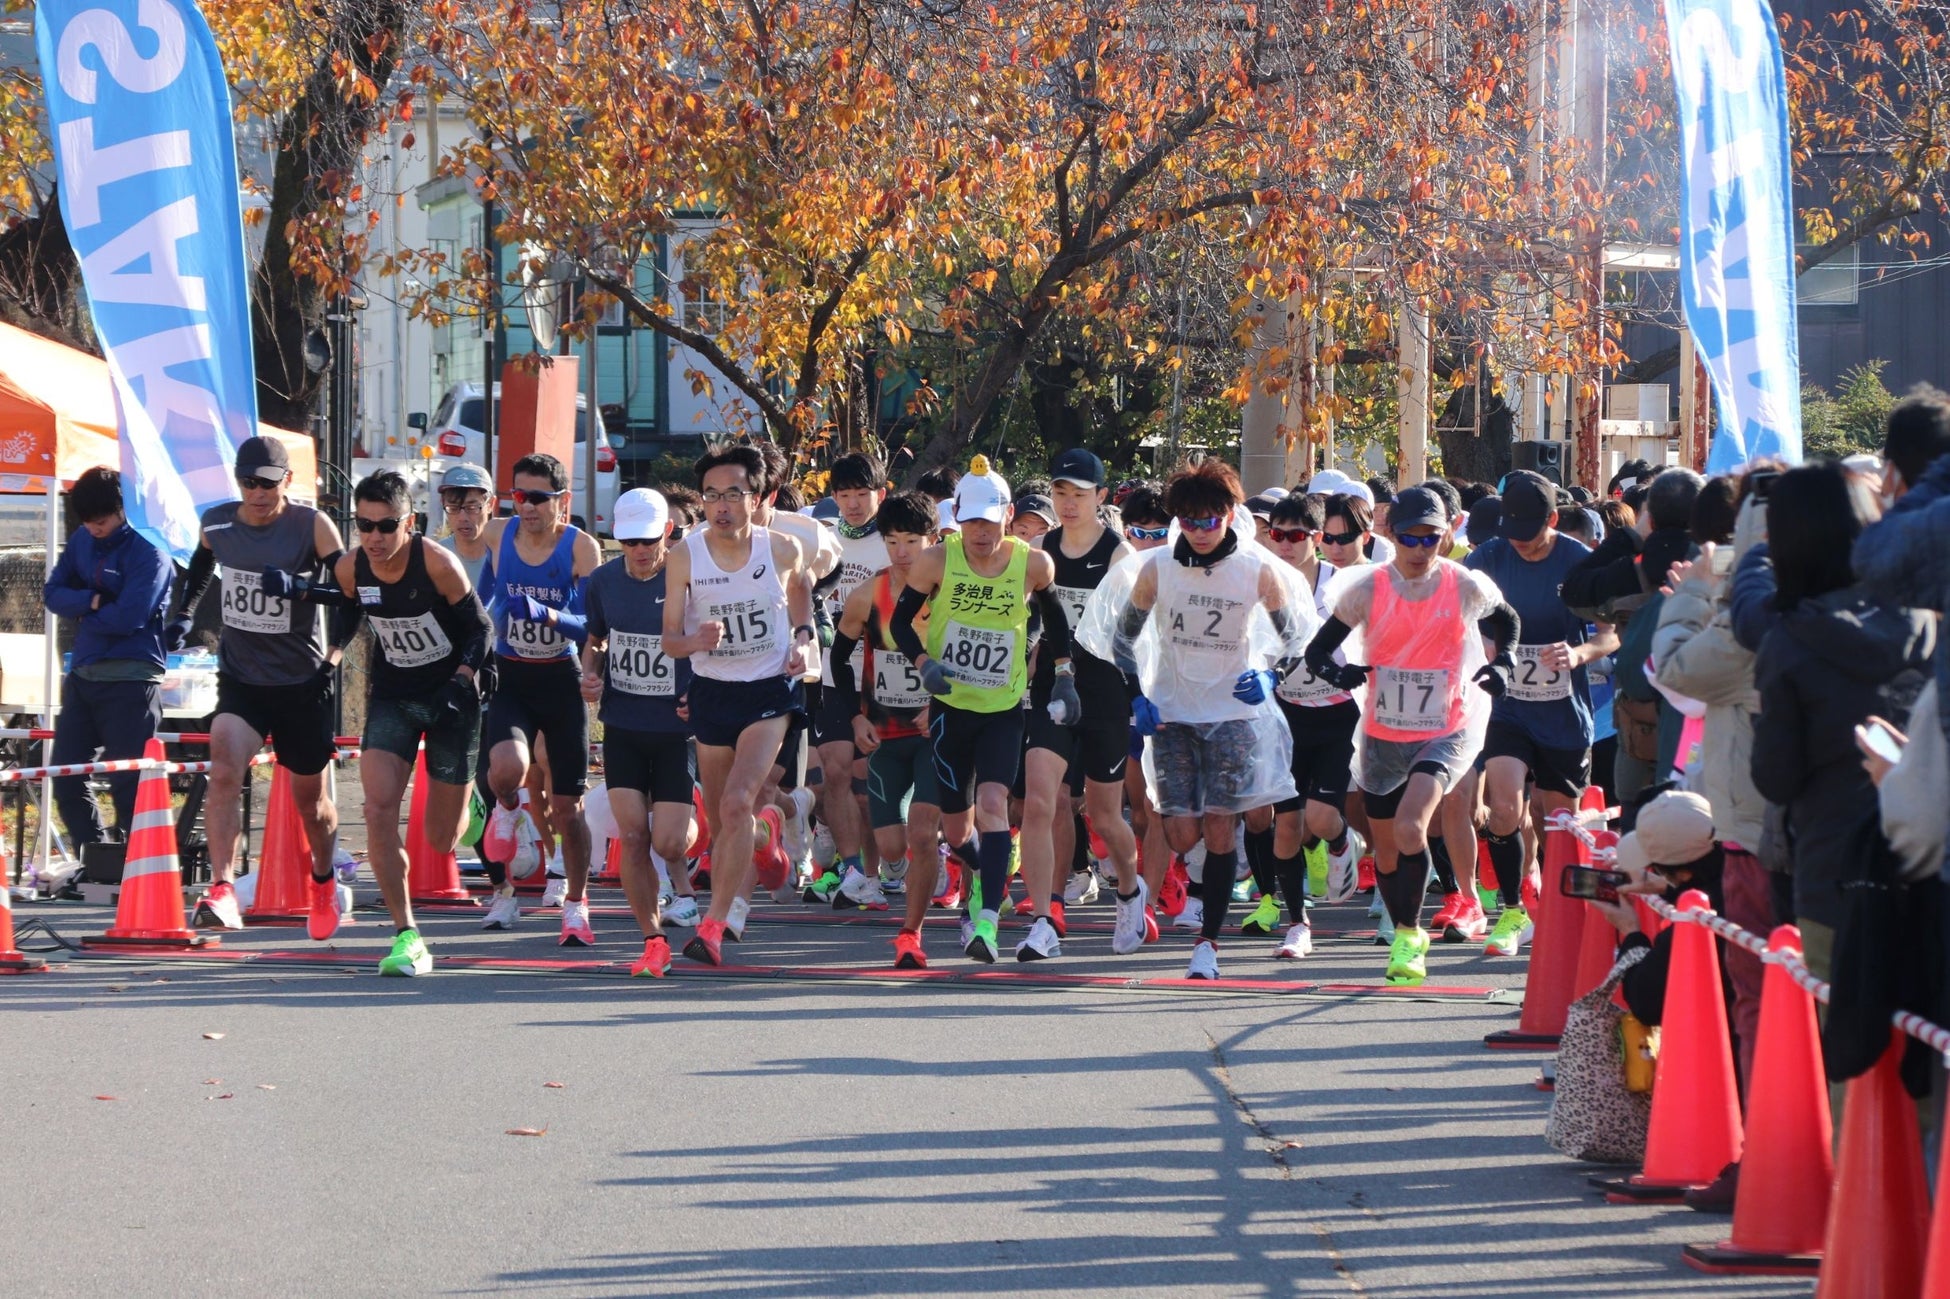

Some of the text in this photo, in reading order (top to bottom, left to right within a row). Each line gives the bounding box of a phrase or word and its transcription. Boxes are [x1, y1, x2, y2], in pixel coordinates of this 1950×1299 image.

[844, 562, 873, 577] MAGAW
[233, 572, 263, 586] 長野
[952, 582, 994, 600] 多治見
[1057, 589, 1087, 602] 野電子
[223, 585, 285, 617] A803
[710, 599, 757, 616] 長野電子
[950, 597, 1014, 616] ランナーズ
[1188, 595, 1233, 610] 長野電子
[380, 619, 421, 630] 長野電子
[509, 620, 566, 645] A80
[722, 609, 767, 643] 415
[382, 627, 438, 654] A401
[616, 634, 661, 649] 長野電子
[958, 627, 1005, 645] 長野電子
[611, 648, 669, 678] A406
[885, 653, 908, 665] 長野
[942, 640, 1009, 673] A802
[1387, 671, 1435, 684] 長野電子
[1376, 684, 1434, 713] A17
